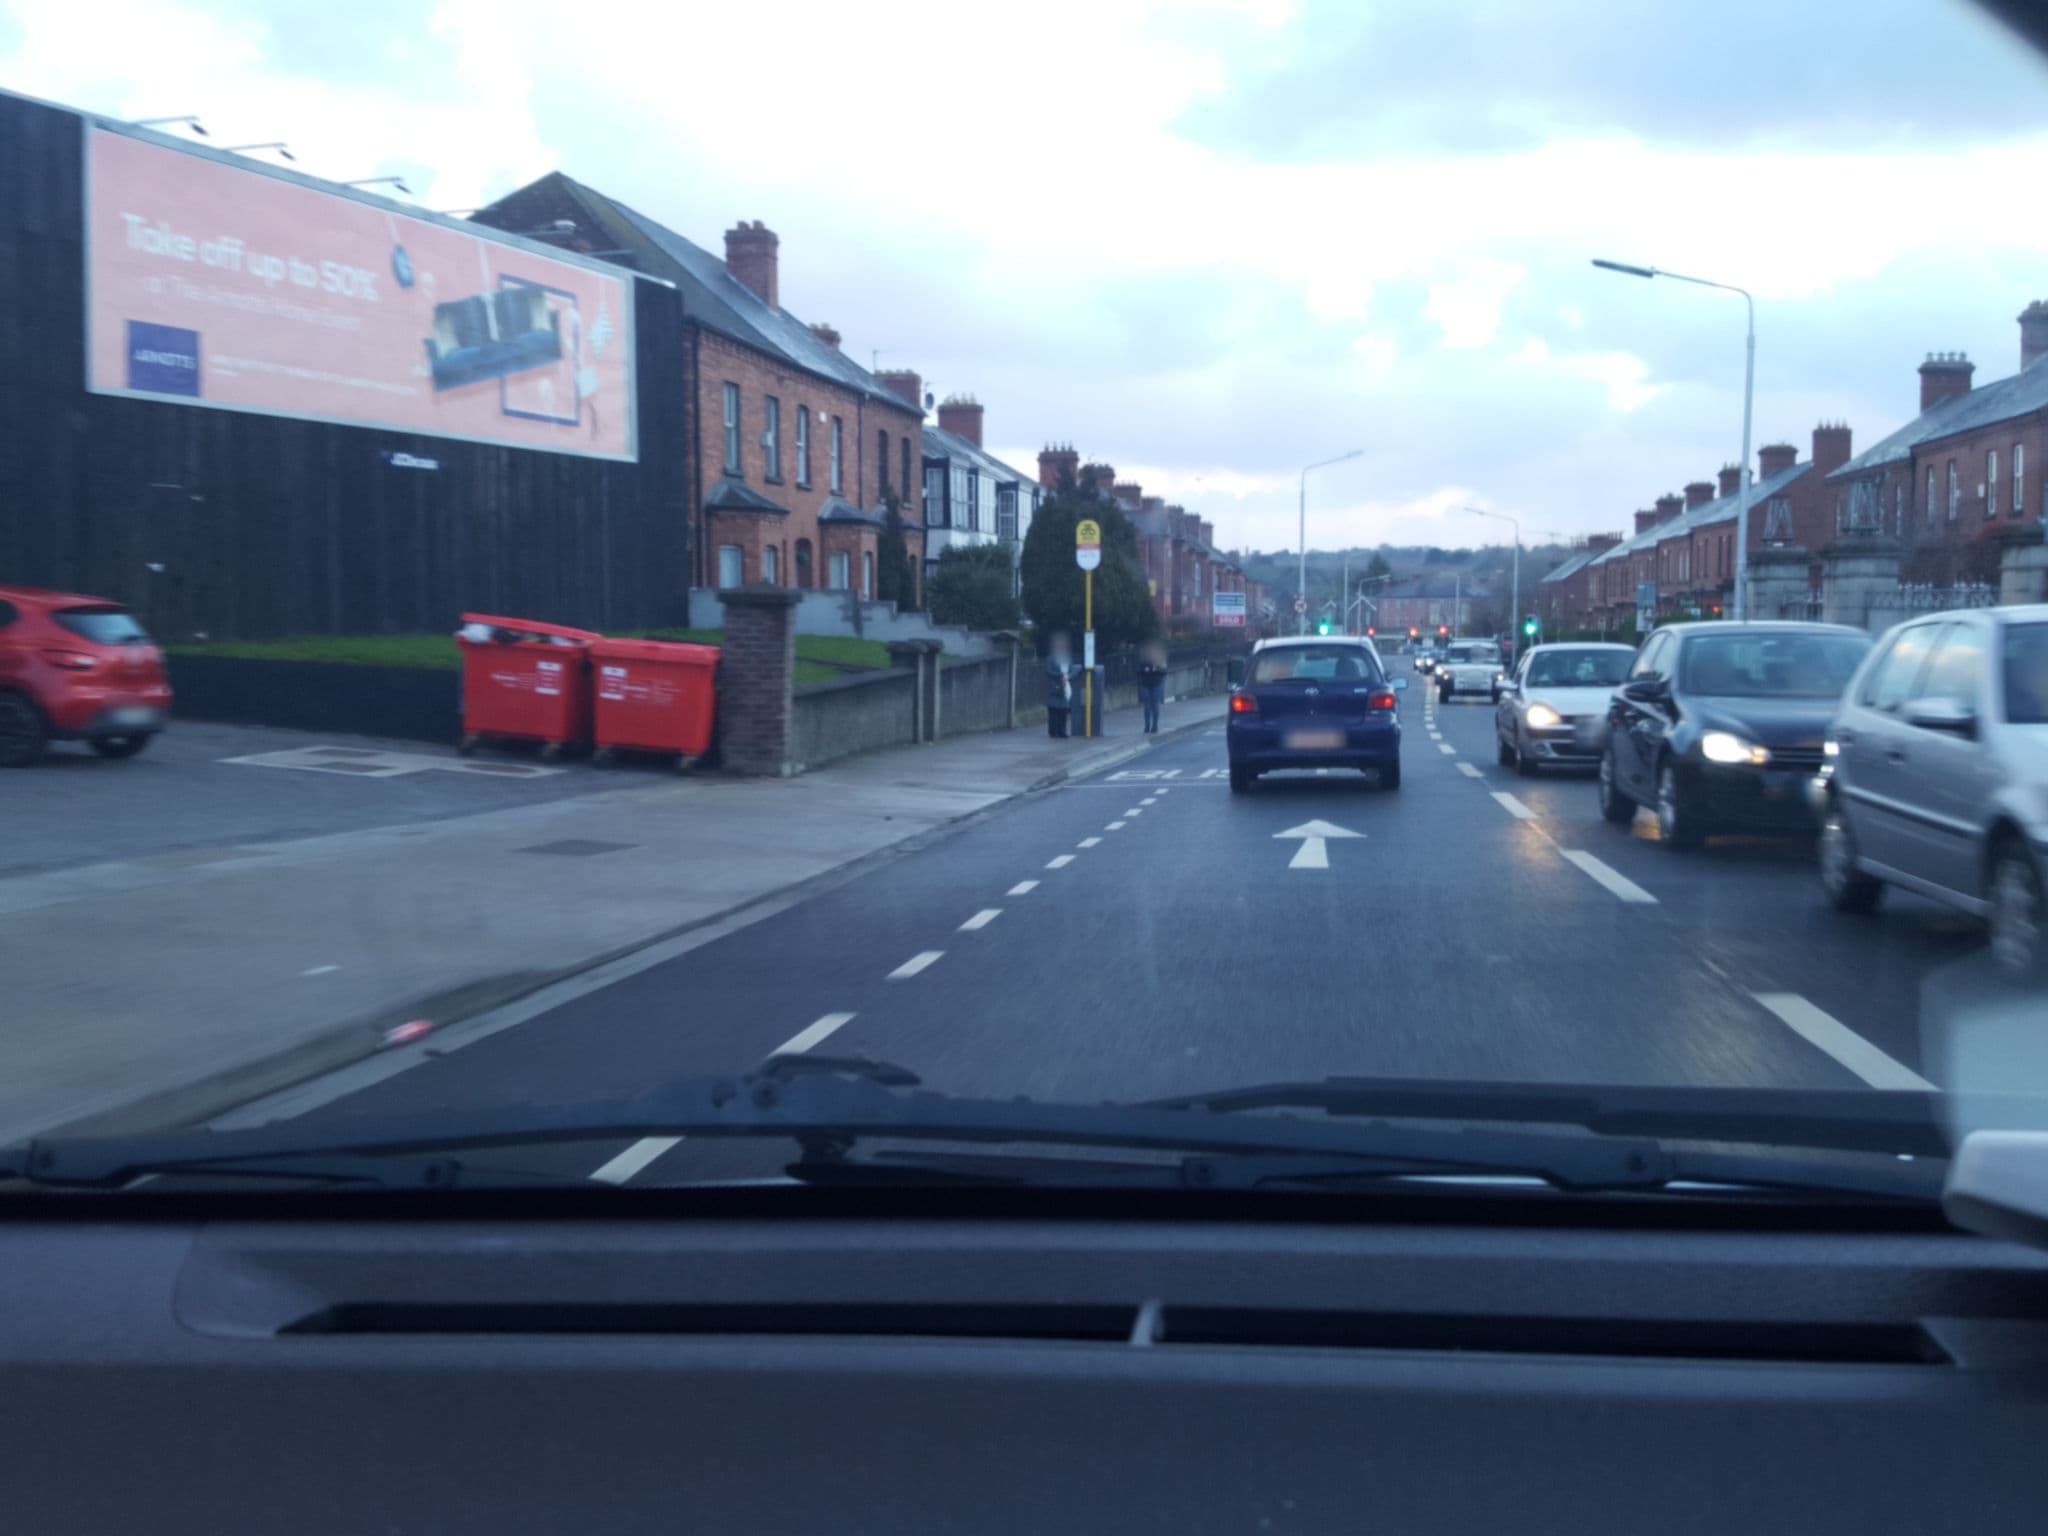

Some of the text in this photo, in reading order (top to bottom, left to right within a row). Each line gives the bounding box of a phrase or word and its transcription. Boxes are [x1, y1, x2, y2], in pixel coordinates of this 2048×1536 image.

[121, 212, 380, 302] Take off up to 50%
